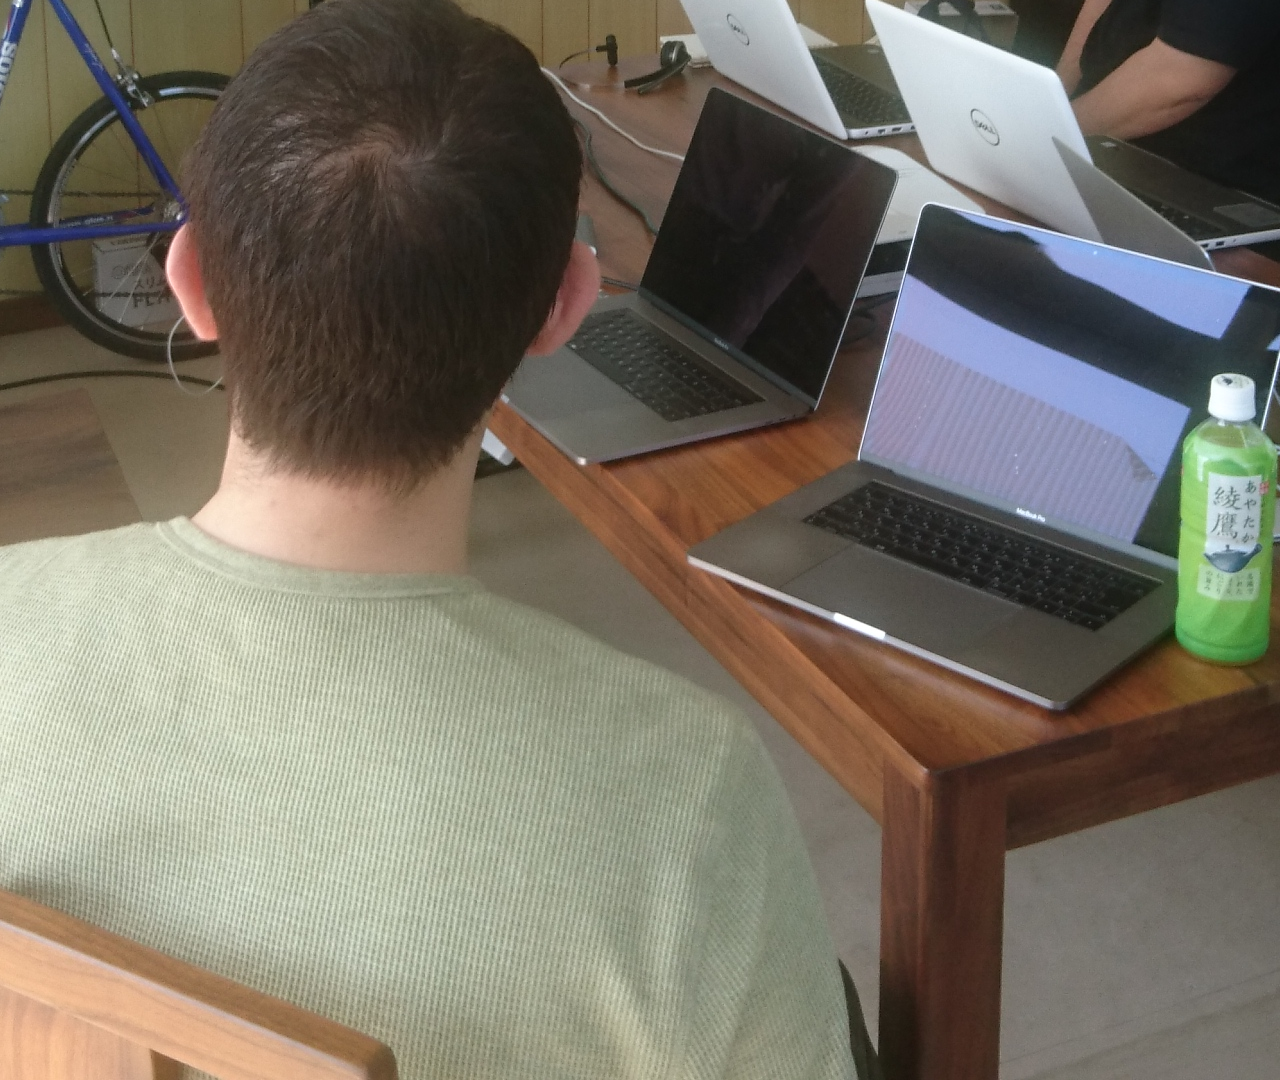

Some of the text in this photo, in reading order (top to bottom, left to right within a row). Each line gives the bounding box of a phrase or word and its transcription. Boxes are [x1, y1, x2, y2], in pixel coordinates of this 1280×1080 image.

[1210, 485, 1242, 540] 綾鷹
[1241, 480, 1258, 543] あやたか
